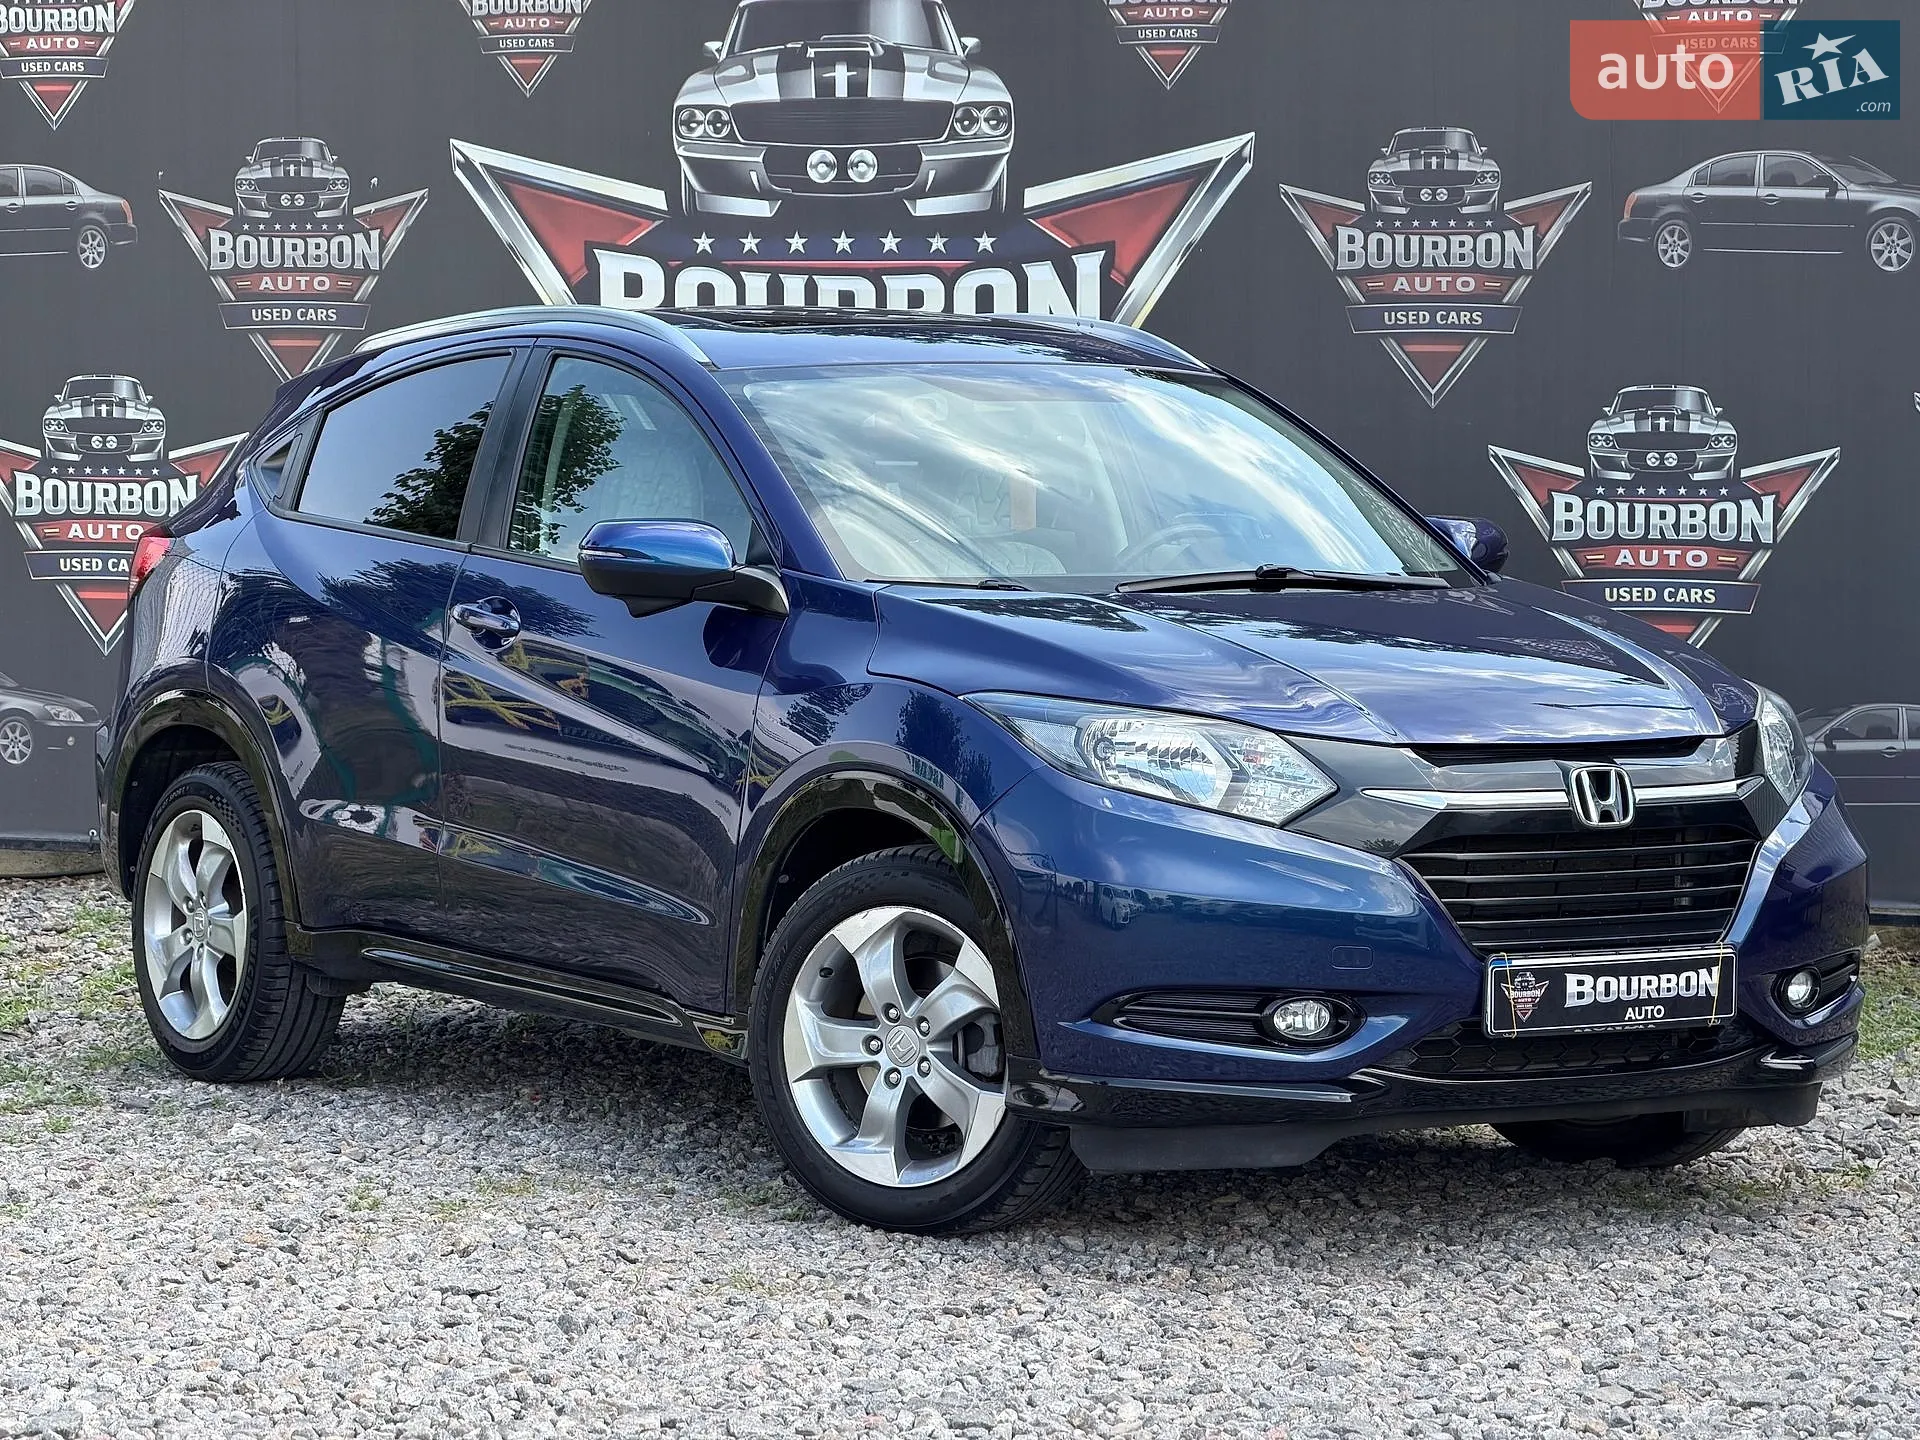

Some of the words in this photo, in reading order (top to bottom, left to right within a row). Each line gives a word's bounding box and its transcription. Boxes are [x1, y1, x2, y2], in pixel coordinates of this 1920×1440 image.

[1143, 7, 1194, 18] AUTO
[1687, 10, 1753, 22] AUTO
[504, 18, 550, 28] AUTO
[1138, 29, 1166, 38] USED
[1169, 28, 1198, 38] CARS
[26, 37, 79, 49] AUTO
[499, 39, 526, 48] USED
[528, 38, 555, 48] CARS
[1680, 38, 1717, 49] USED
[1720, 36, 1758, 48] CARS
[21, 62, 51, 72] USED
[54, 61, 85, 72] CARS
[209, 228, 381, 270] BOURBON
[1335, 225, 1535, 269] BOURBON
[259, 276, 331, 291] AUTO
[1393, 276, 1477, 293] AUTO
[251, 308, 292, 321] USED
[296, 308, 337, 321] CARS
[1383, 311, 1430, 326] USED
[1436, 311, 1483, 326] CARS
[14, 471, 198, 517] BOURBON
[1552, 492, 1775, 543] BOURBON
[67, 523, 144, 540] AUTO
[59, 558, 103, 572] USED
[107, 558, 132, 572] CA
[1614, 550, 1709, 568] AUTO
[1604, 587, 1657, 603] USED
[1663, 587, 1716, 604] CARS
[1564, 966, 1720, 1007] BOURBON
[1624, 1005, 1665, 1020] AUTO
